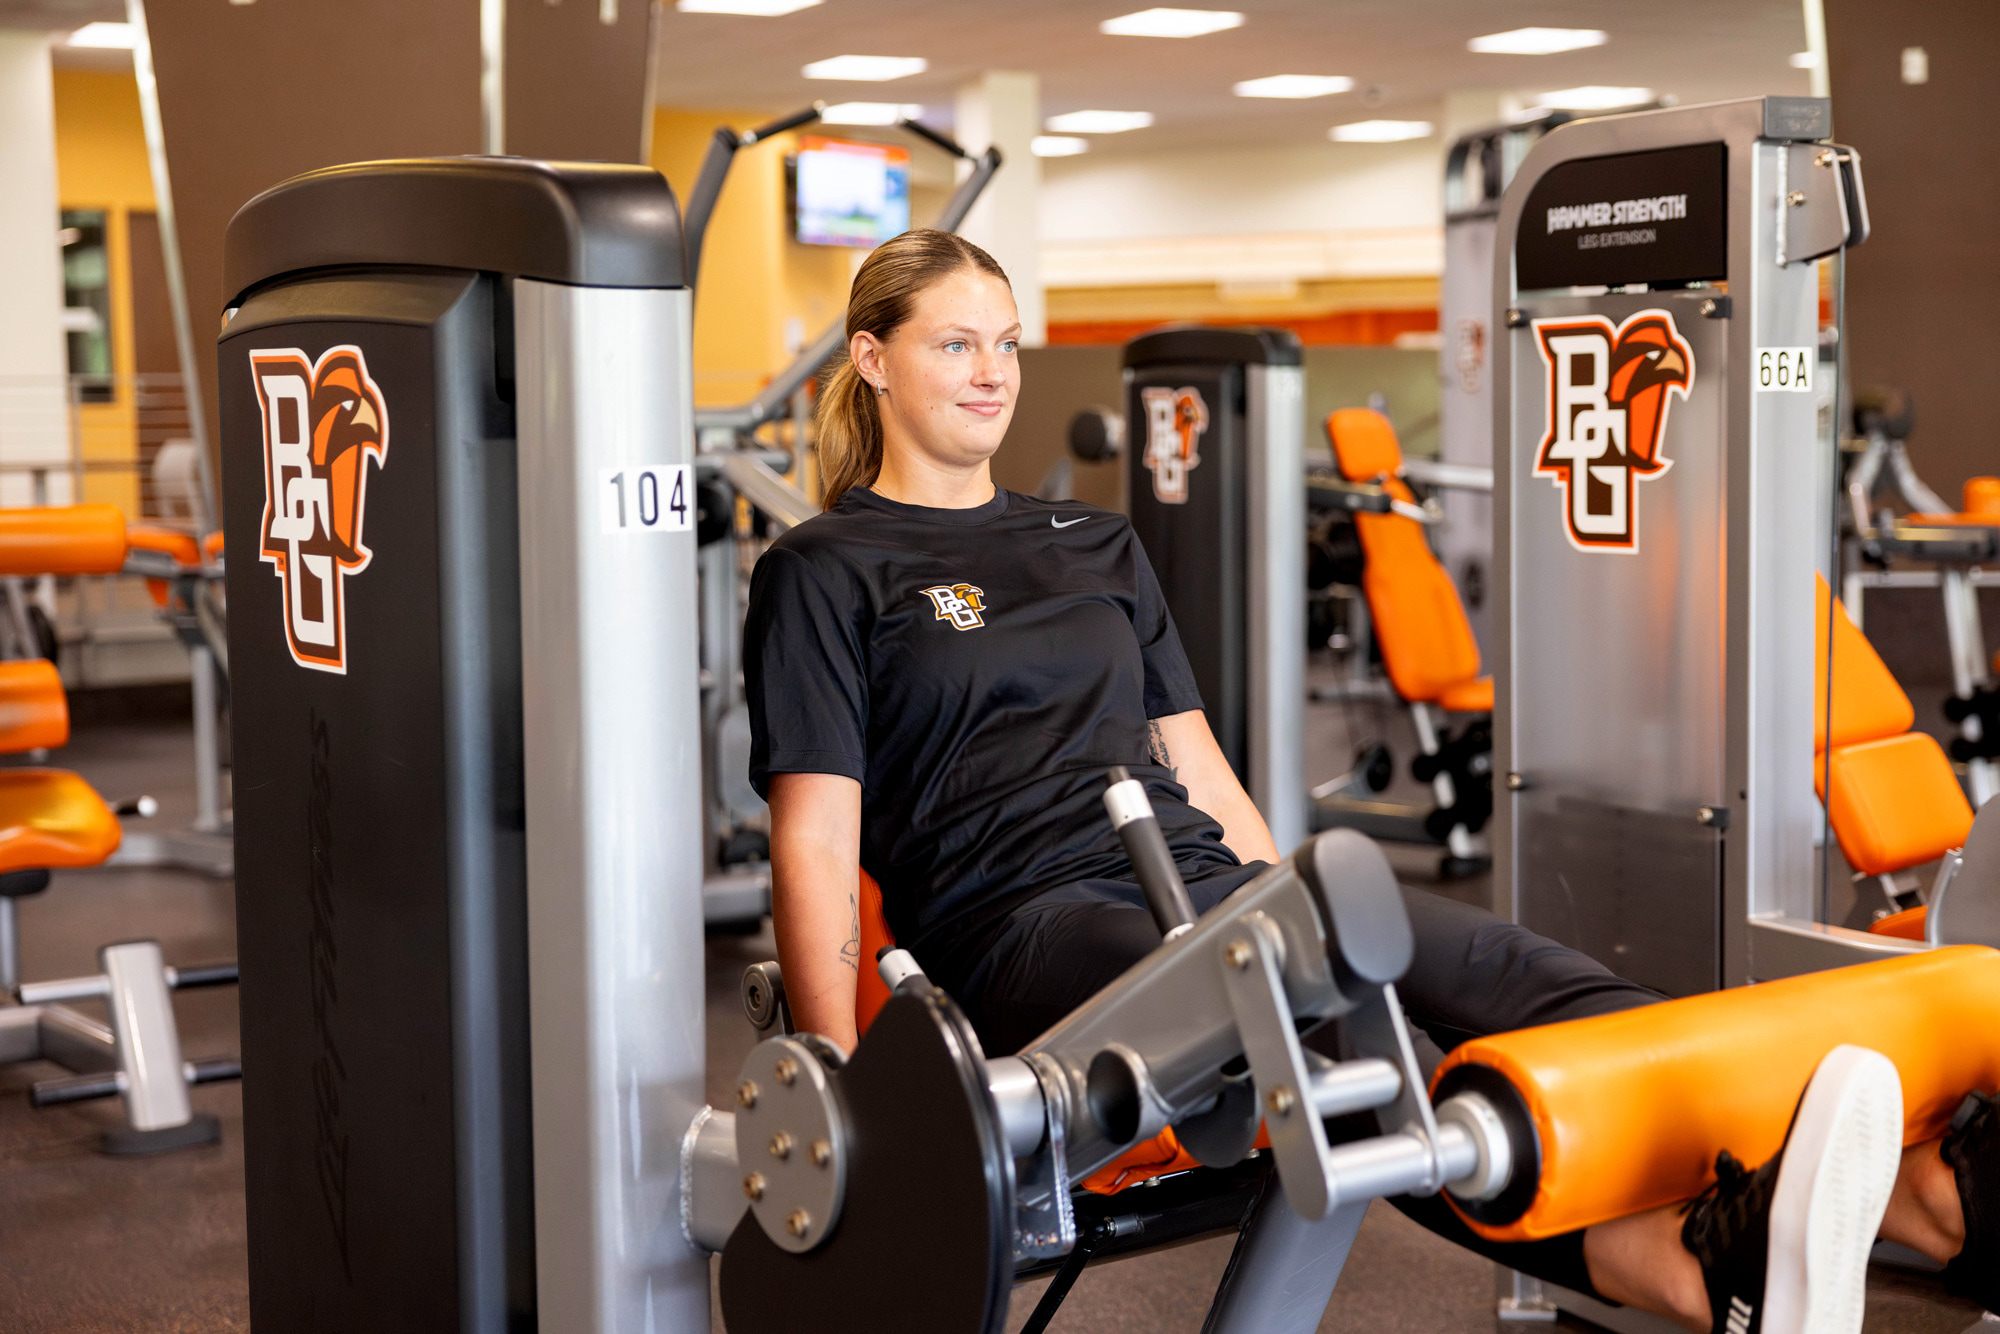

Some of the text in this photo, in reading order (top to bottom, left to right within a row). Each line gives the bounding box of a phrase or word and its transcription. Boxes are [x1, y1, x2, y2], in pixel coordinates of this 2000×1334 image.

[1547, 194, 1688, 235] HAMMER STRENGTH
[1577, 228, 1657, 250] LEG EXTENSION
[1759, 350, 1808, 388] 66A
[1537, 322, 1635, 547] BG
[255, 359, 343, 662] BG
[609, 469, 688, 528] 104
